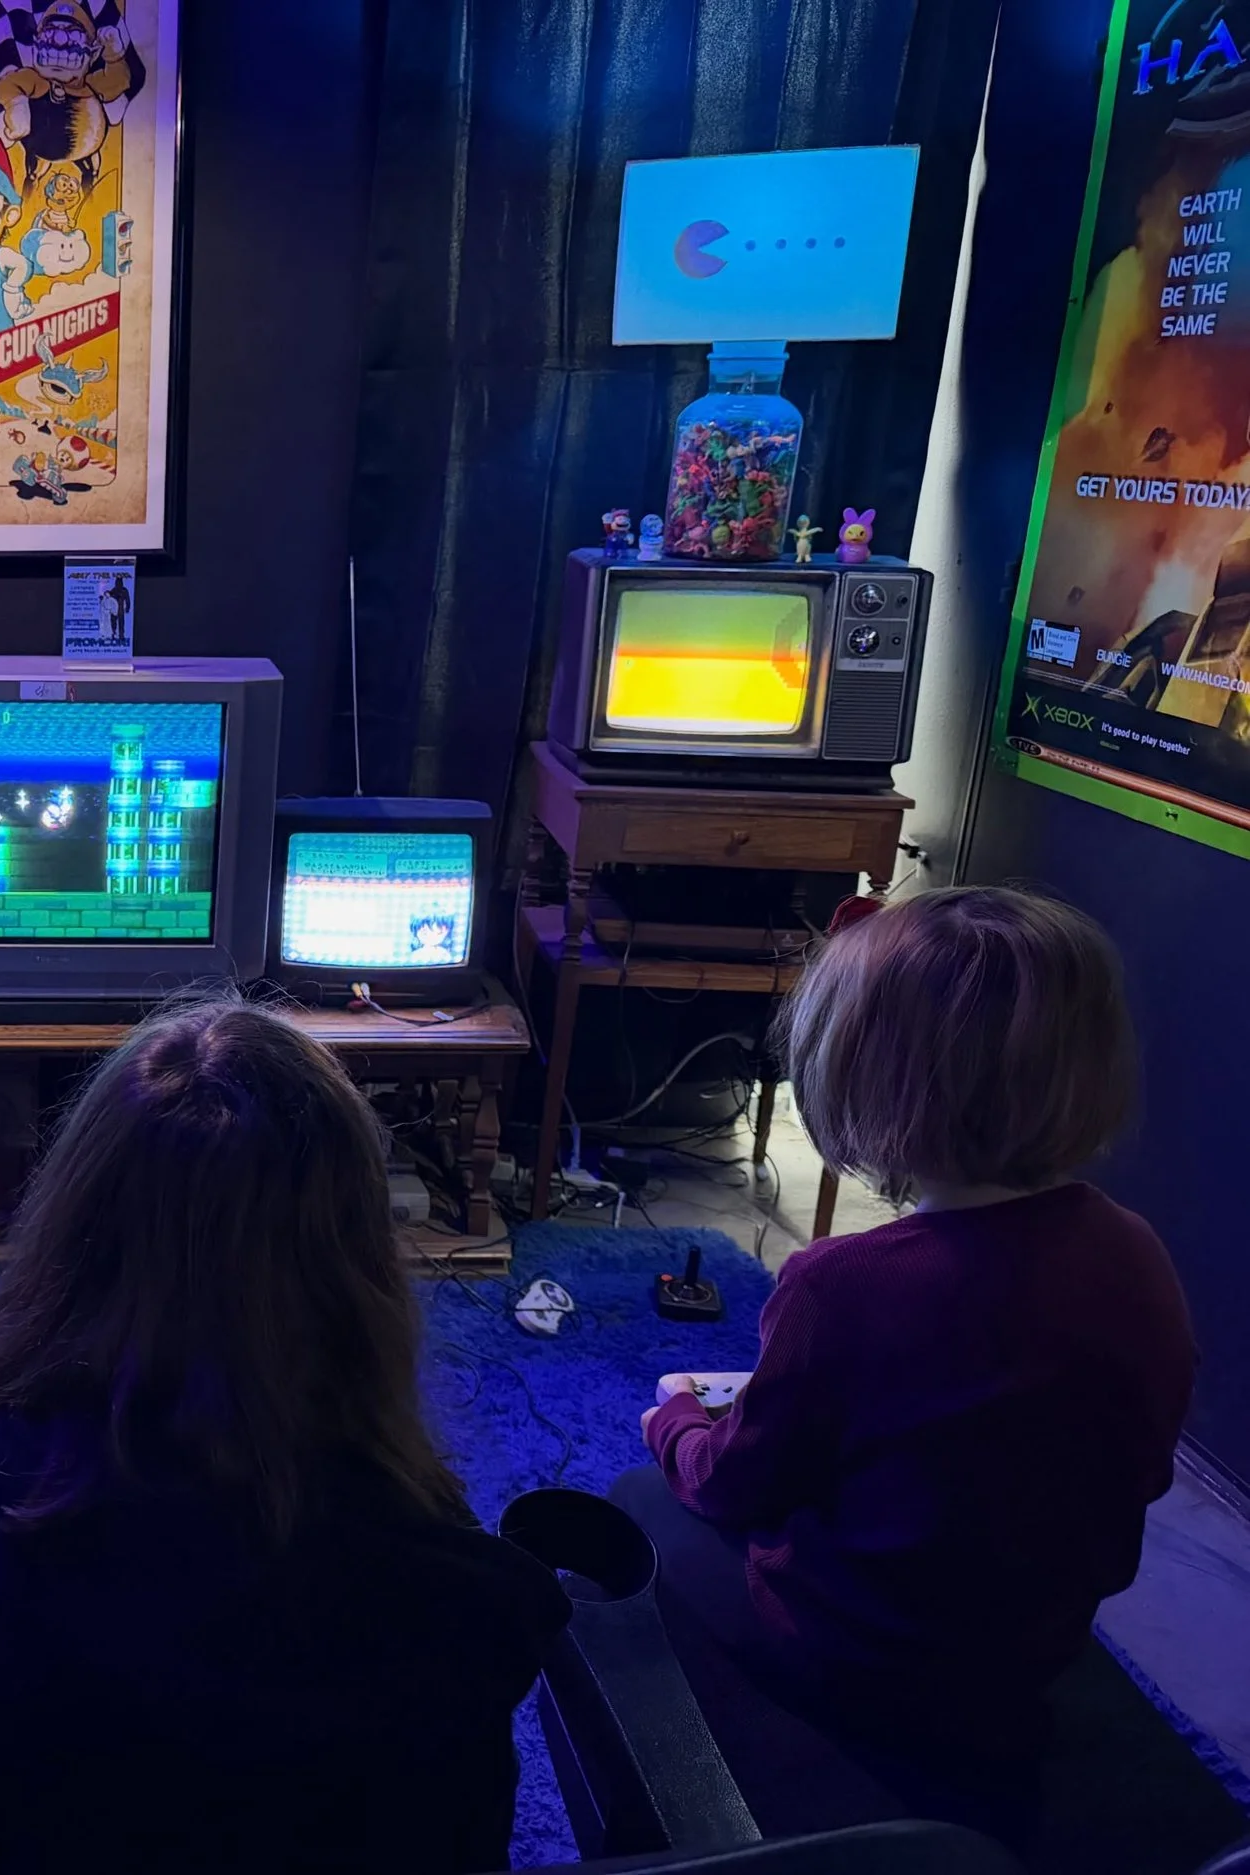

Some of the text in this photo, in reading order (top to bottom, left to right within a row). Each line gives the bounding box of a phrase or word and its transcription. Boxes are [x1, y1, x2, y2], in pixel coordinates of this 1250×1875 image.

[1179, 188, 1242, 217] EARTH
[1182, 225, 1226, 247] WILL
[1167, 252, 1231, 278] NEVER
[1160, 282, 1228, 308] BE THE
[42, 299, 109, 345] NIGHTS
[1161, 313, 1217, 337] SAME
[1076, 475, 1109, 498] GET
[1114, 477, 1177, 504] YOURS
[1031, 627, 1045, 650] M
[1096, 648, 1132, 668] BUNGIE
[2, 711, 11, 724] 0
[1043, 703, 1095, 732] XBOX
[1101, 721, 1191, 756] It's good to play together
